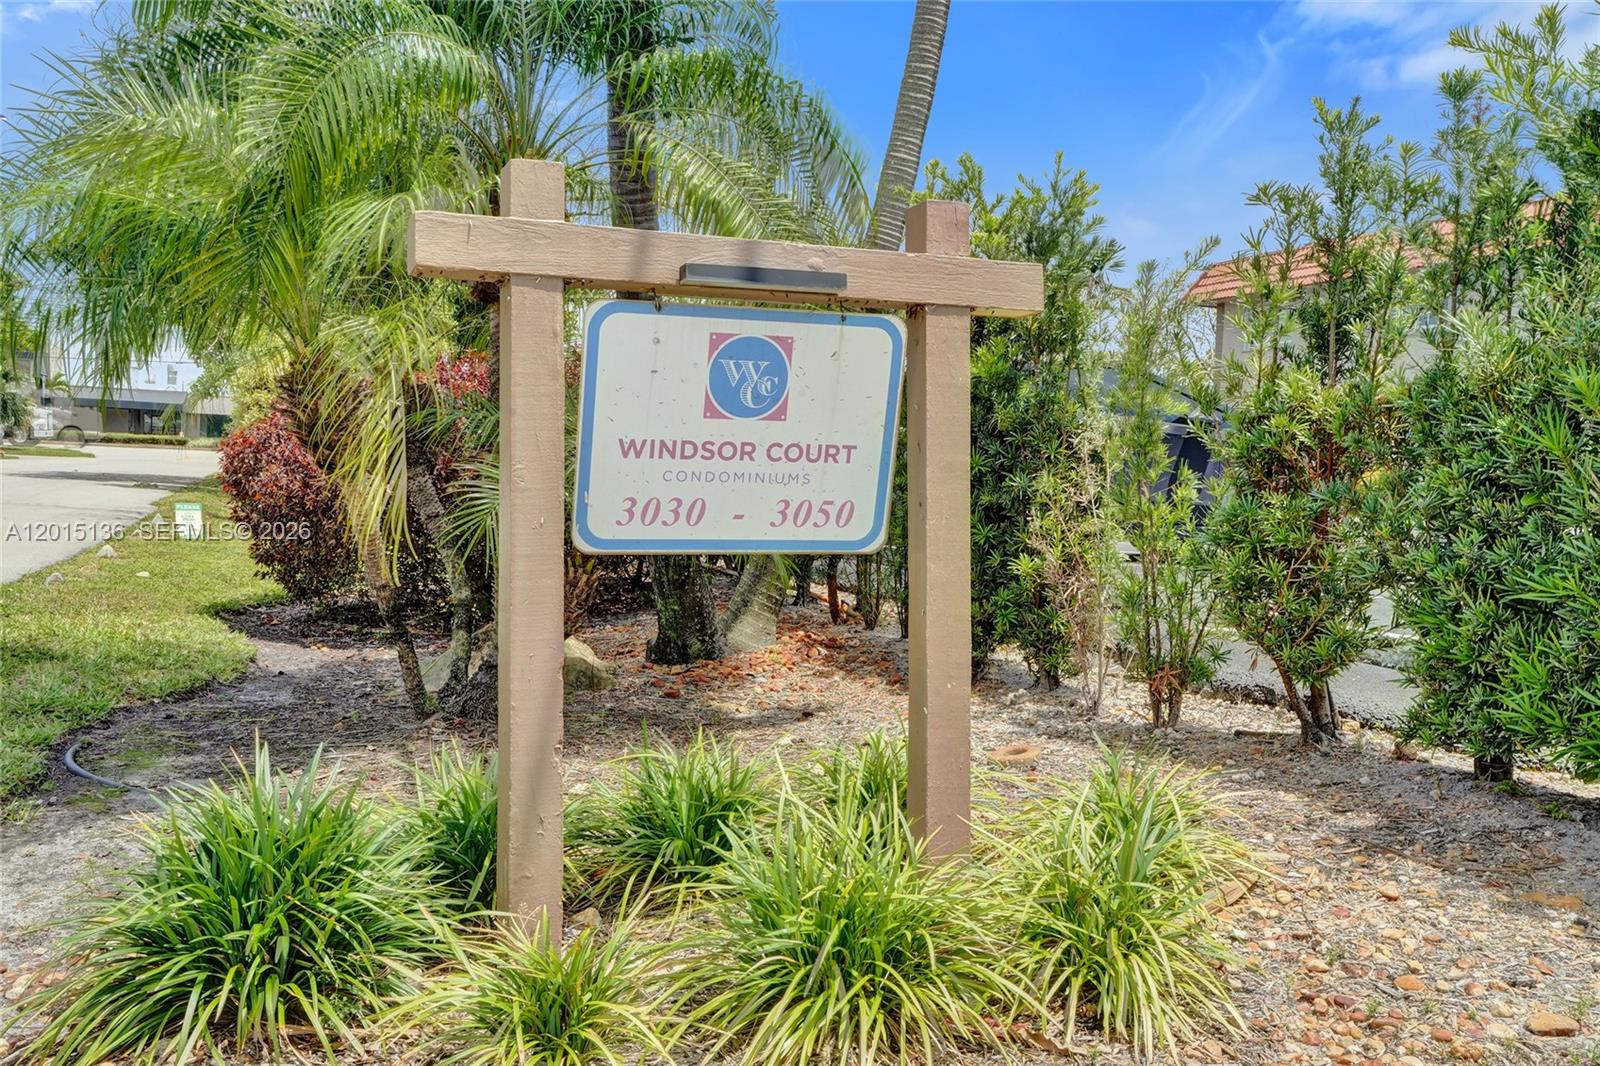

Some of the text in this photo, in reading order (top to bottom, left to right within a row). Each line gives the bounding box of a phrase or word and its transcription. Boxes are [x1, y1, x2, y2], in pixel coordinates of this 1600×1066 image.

[617, 438, 858, 465] WINDSOR COURT
[662, 470, 811, 486] CONDOMINIUMS
[615, 496, 707, 527] 3030
[769, 498, 856, 529] 3050
